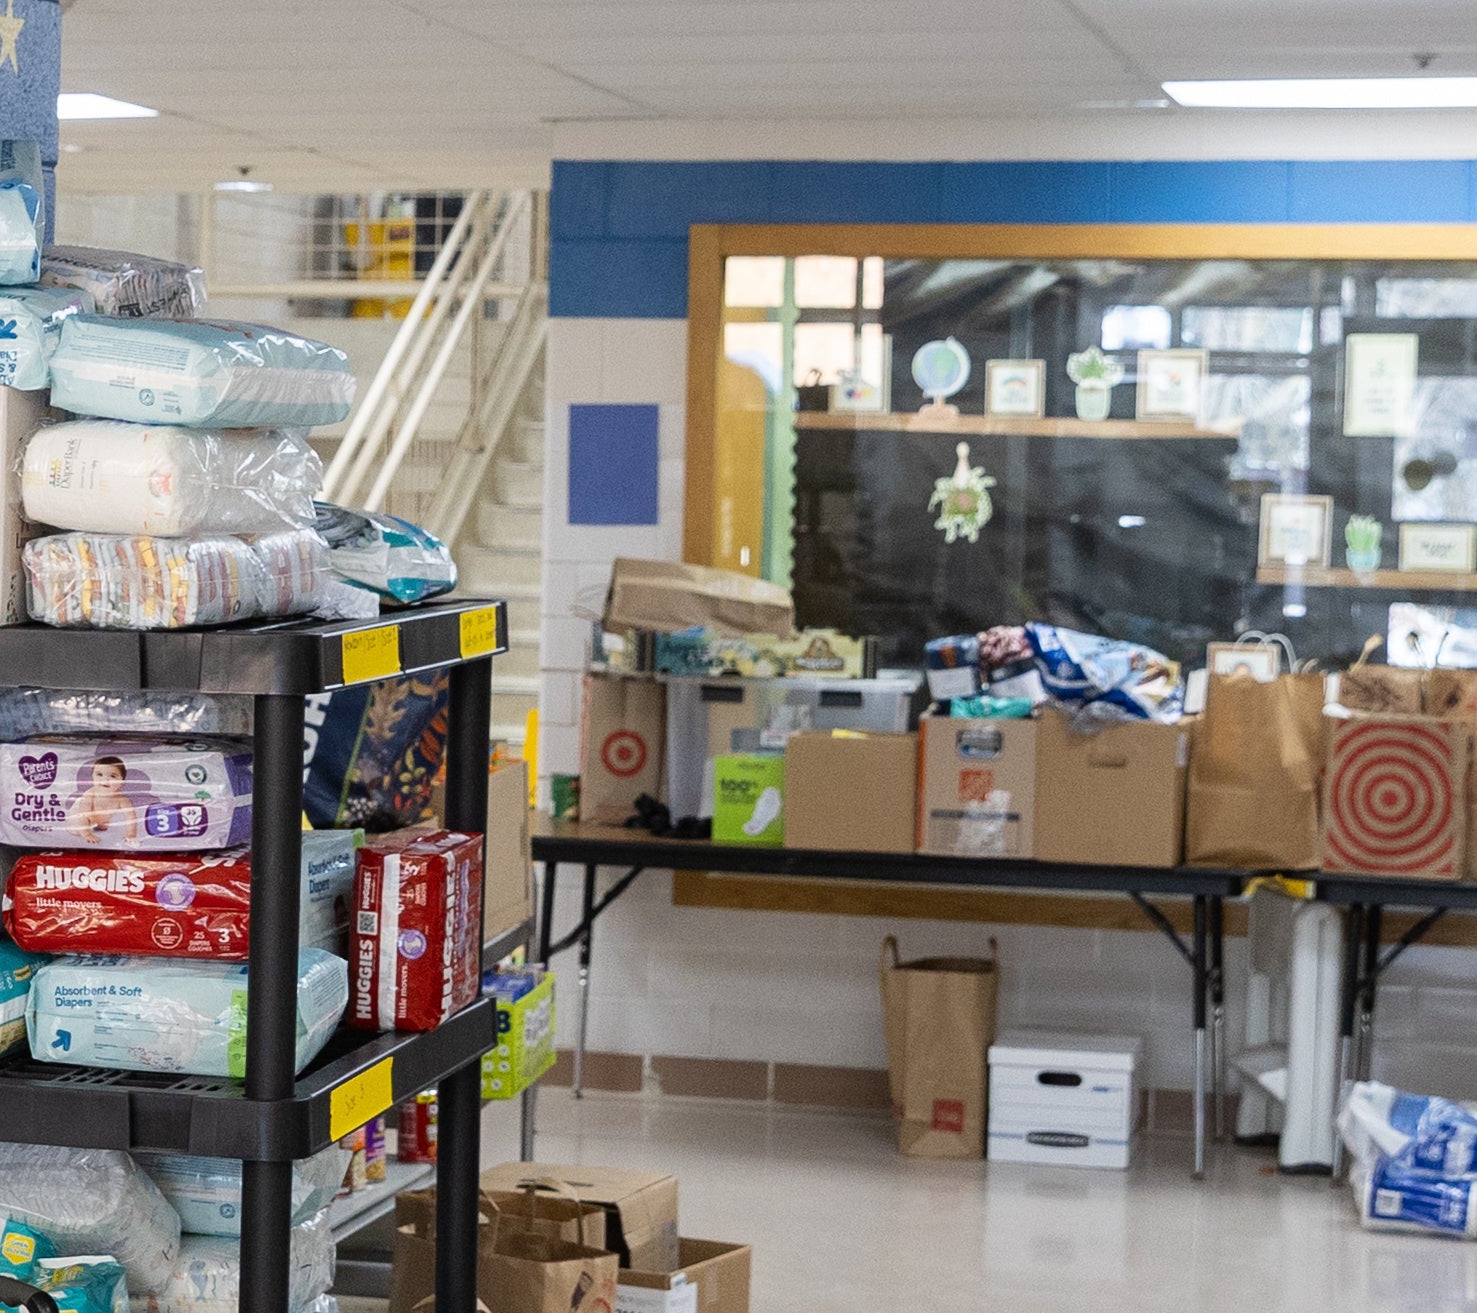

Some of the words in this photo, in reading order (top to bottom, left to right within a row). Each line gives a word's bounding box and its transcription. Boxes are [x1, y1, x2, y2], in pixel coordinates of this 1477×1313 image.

[22, 757, 56, 775] Parent's
[14, 792, 45, 810] Dry
[48, 793, 62, 807] &
[11, 807, 66, 823] Gentle
[156, 814, 170, 832] 3
[35, 864, 146, 894] HUGGIES
[35, 896, 62, 908] little
[218, 928, 231, 943] 3
[356, 938, 374, 1020] HUGGIES
[54, 984, 108, 997] Absorbent
[108, 985, 118, 997] &
[119, 985, 143, 998] Soft
[55, 996, 93, 1008] Diapers
